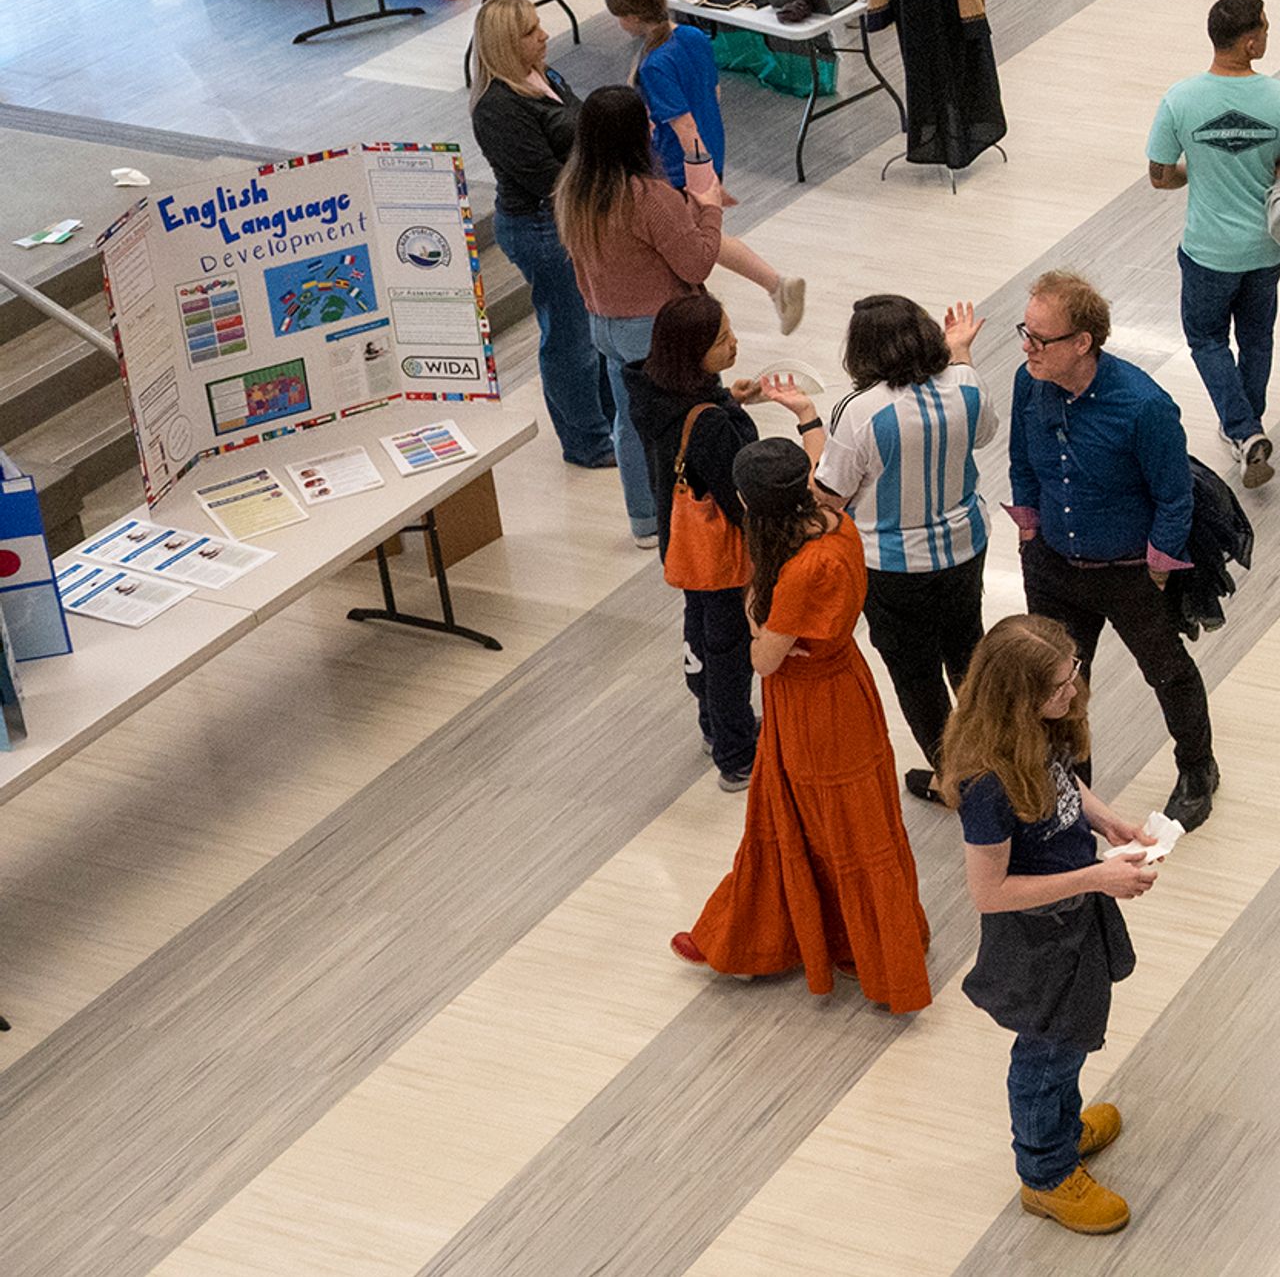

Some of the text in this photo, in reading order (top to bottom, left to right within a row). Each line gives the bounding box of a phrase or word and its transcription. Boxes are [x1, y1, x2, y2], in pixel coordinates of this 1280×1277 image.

[157, 179, 269, 232] English
[218, 194, 350, 245] Language
[200, 212, 368, 273] Development
[425, 361, 474, 375] WIDA
